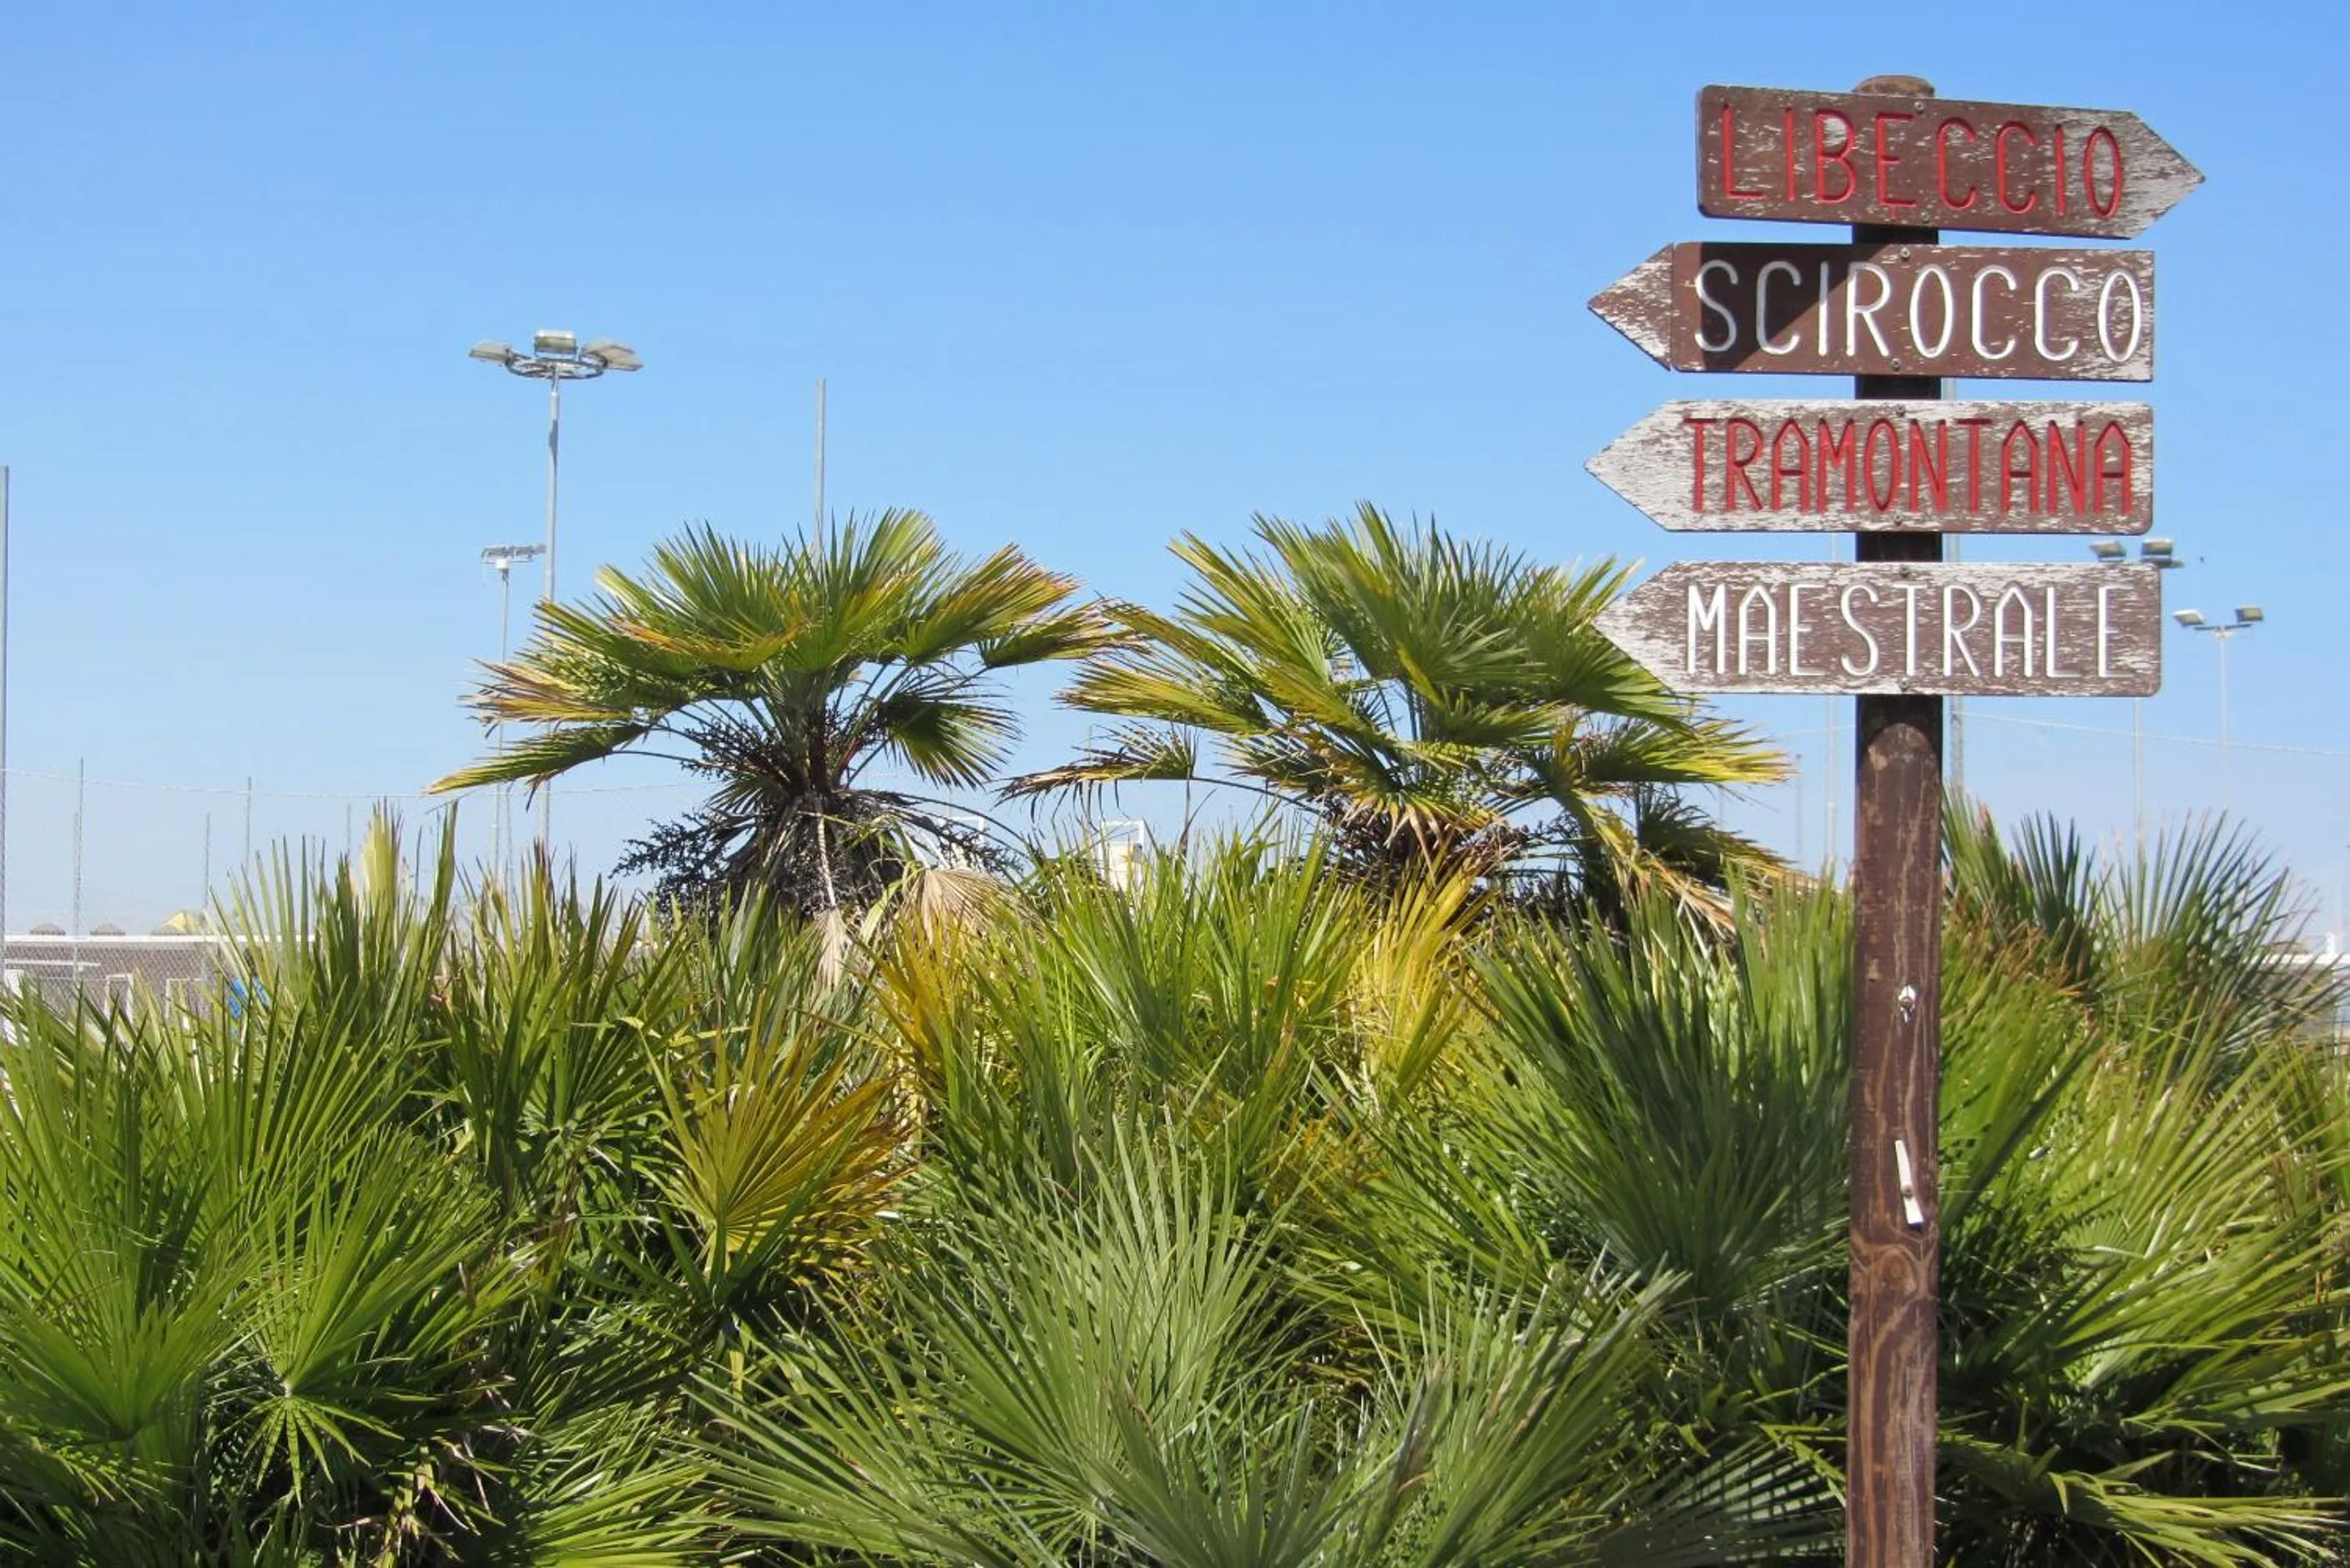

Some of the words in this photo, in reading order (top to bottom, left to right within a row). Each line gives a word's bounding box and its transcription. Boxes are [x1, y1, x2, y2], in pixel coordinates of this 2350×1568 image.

[1721, 101, 2124, 219] LIBECCIO
[1693, 260, 2142, 363] SCIROCCO
[1682, 415, 2133, 515] TRAMONTANA
[1686, 582, 2135, 678] MAESTRALE
